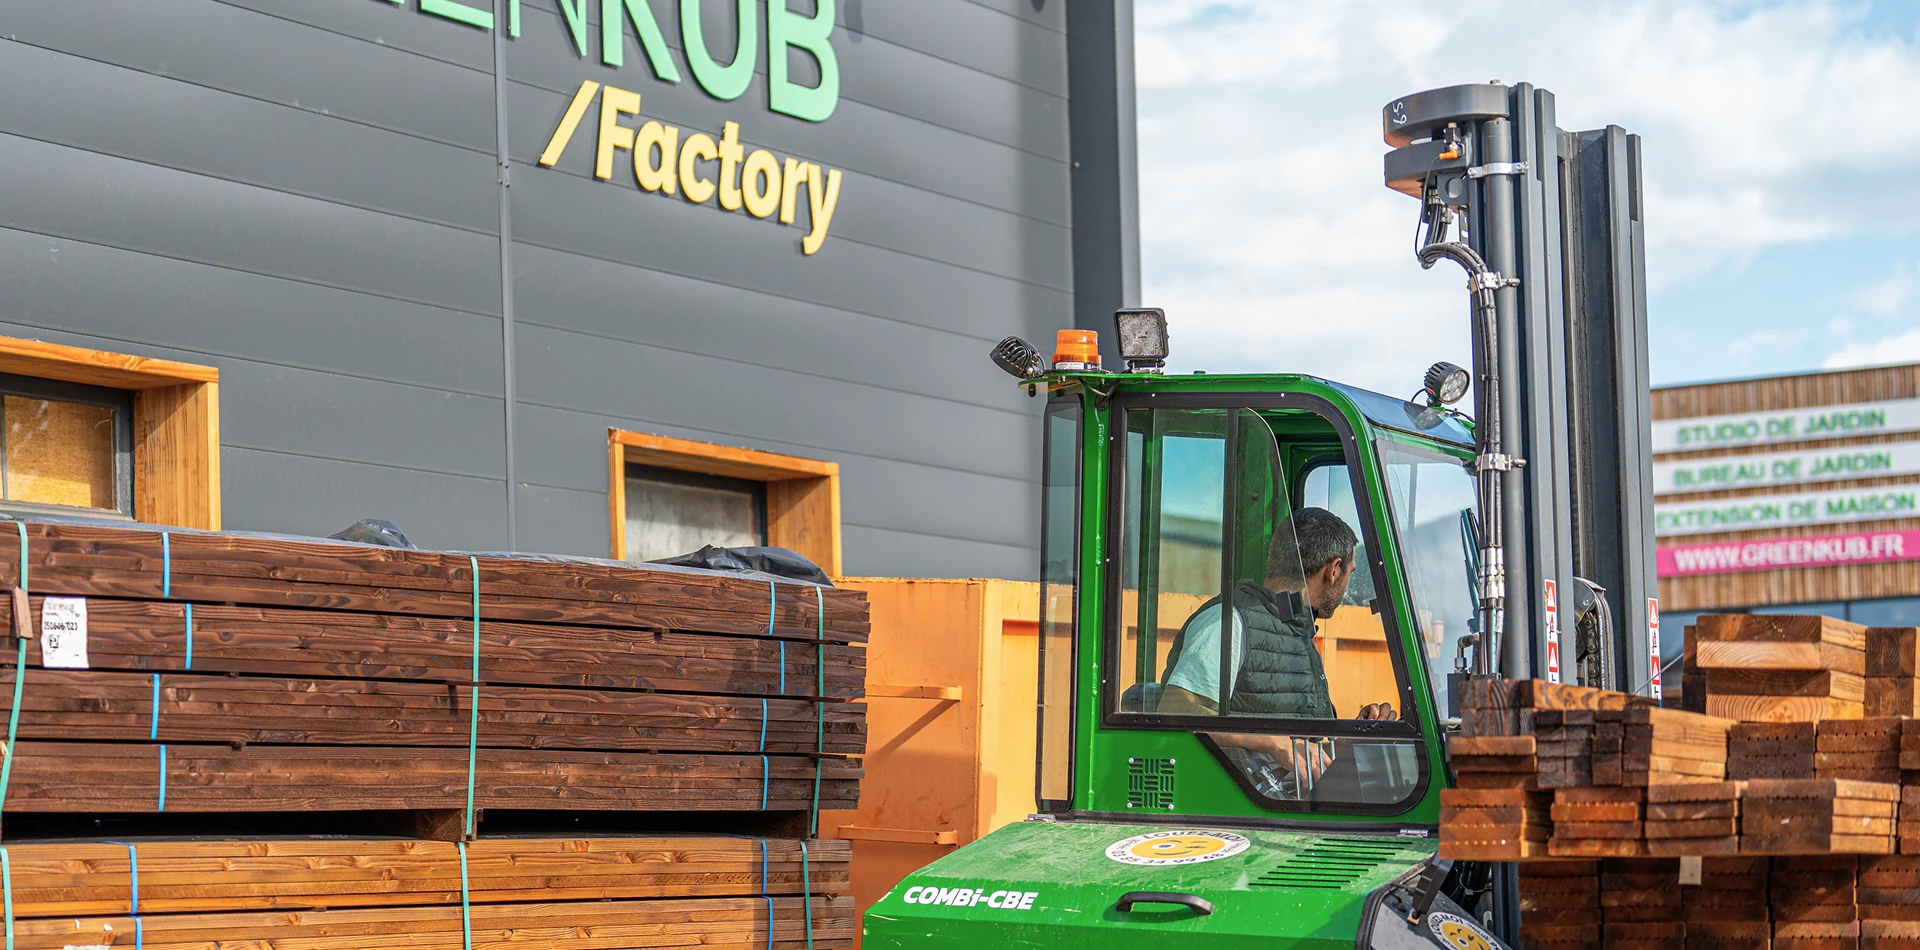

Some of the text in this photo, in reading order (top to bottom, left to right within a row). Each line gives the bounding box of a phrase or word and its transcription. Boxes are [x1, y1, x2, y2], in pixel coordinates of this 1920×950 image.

[540, 80, 842, 255] /Factory
[1677, 409, 1886, 445] STUDIO DE JARDIN
[1673, 451, 1892, 487] BUREAU DE JARDIN
[1656, 492, 1916, 530] EXTENSION DE MAISON
[1673, 533, 1904, 572] WWW.GREENKUB.FR
